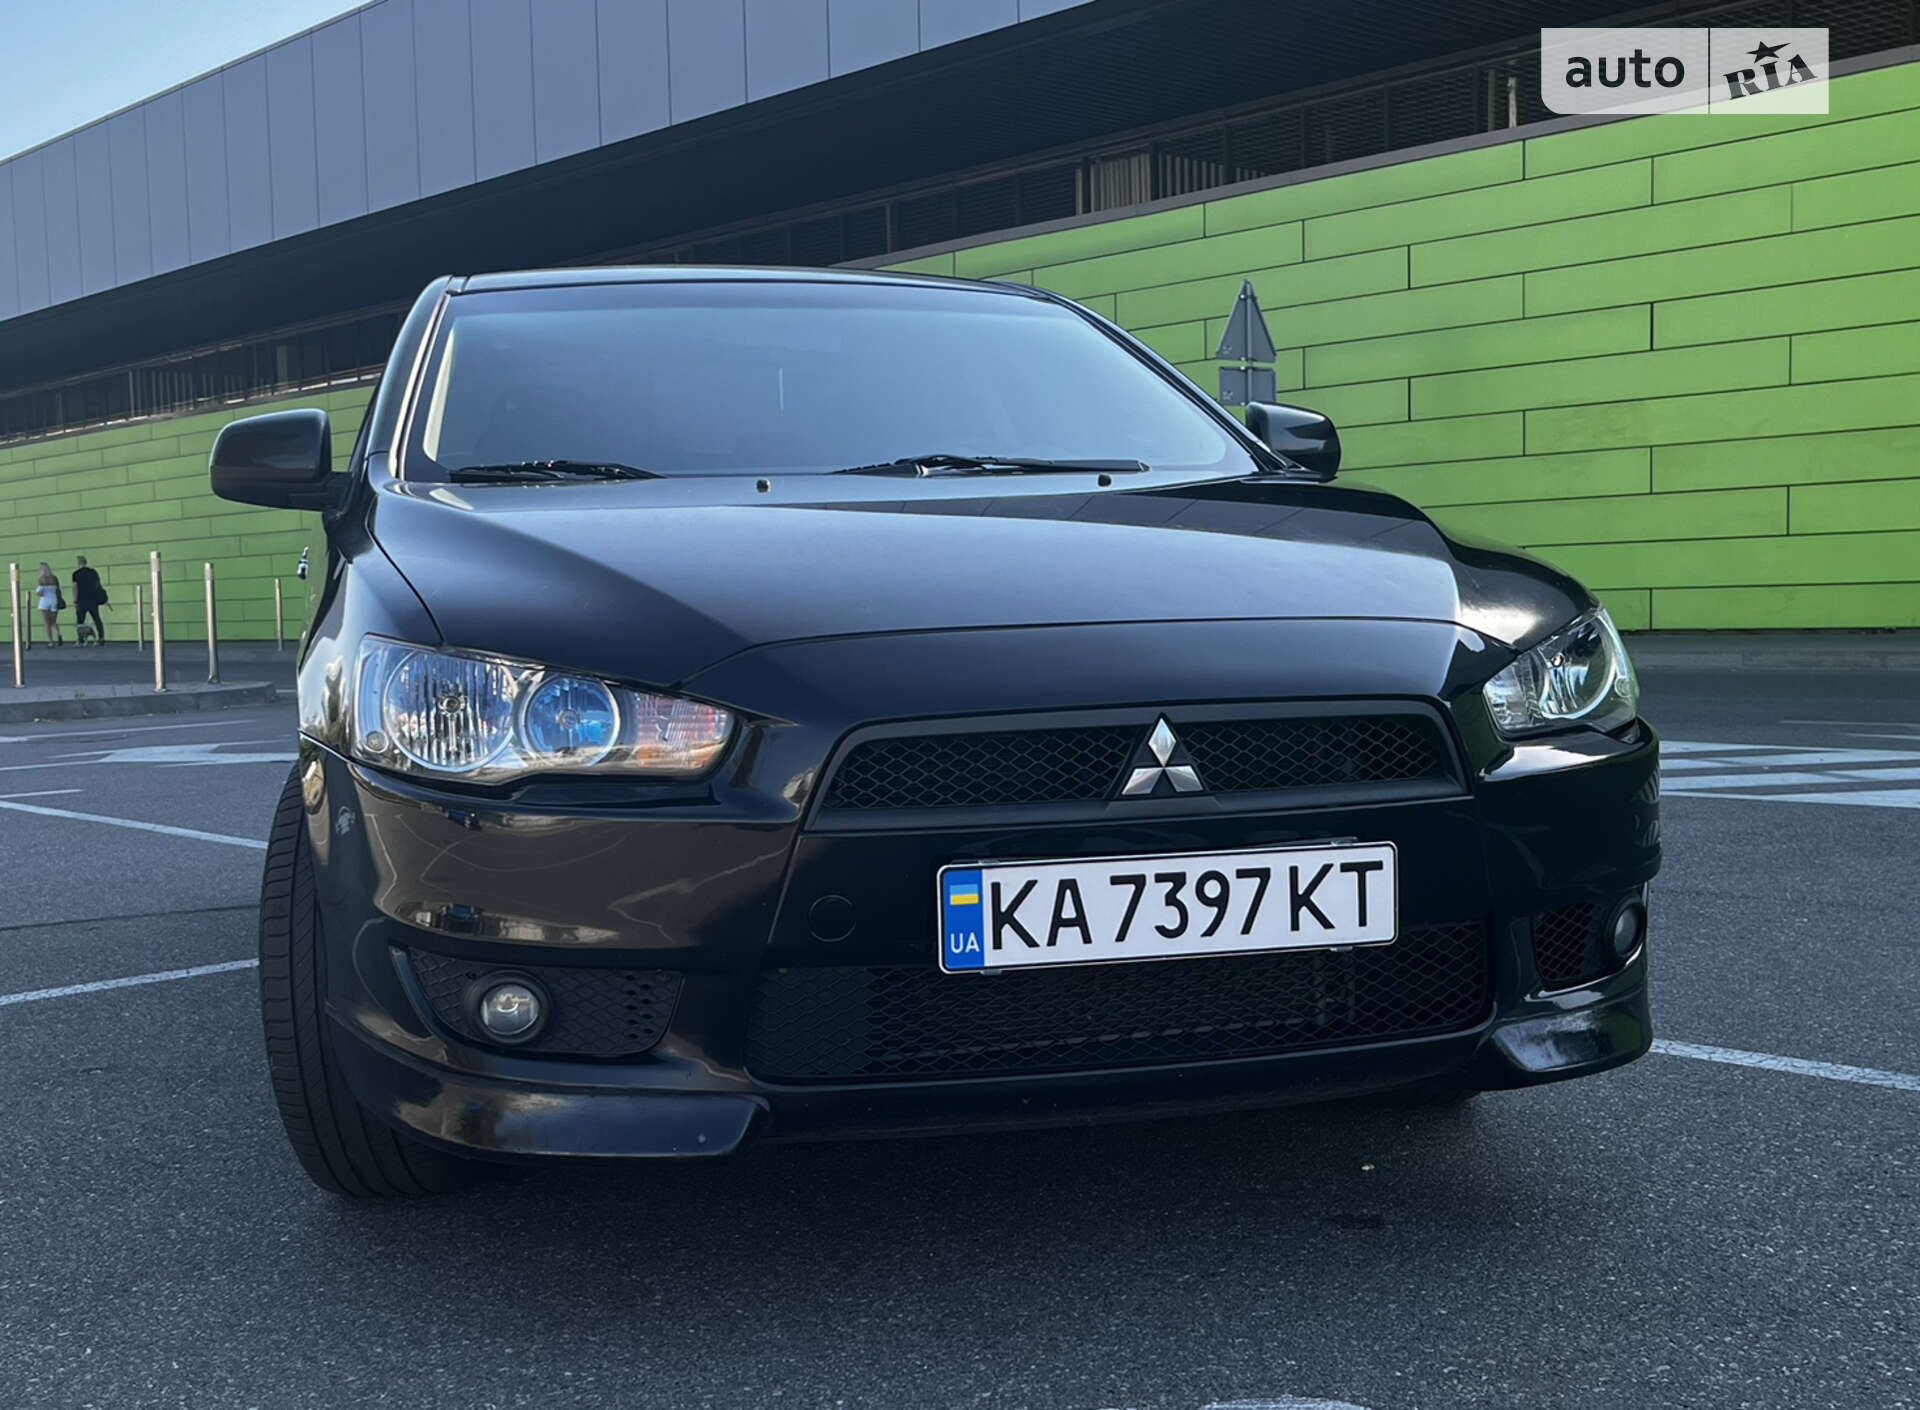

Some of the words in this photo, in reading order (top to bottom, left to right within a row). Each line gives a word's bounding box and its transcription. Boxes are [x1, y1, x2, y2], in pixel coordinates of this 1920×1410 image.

[991, 878, 1092, 950] KA
[1110, 867, 1271, 942] 7397
[1289, 860, 1384, 932] KT
[950, 932, 980, 954] UA
